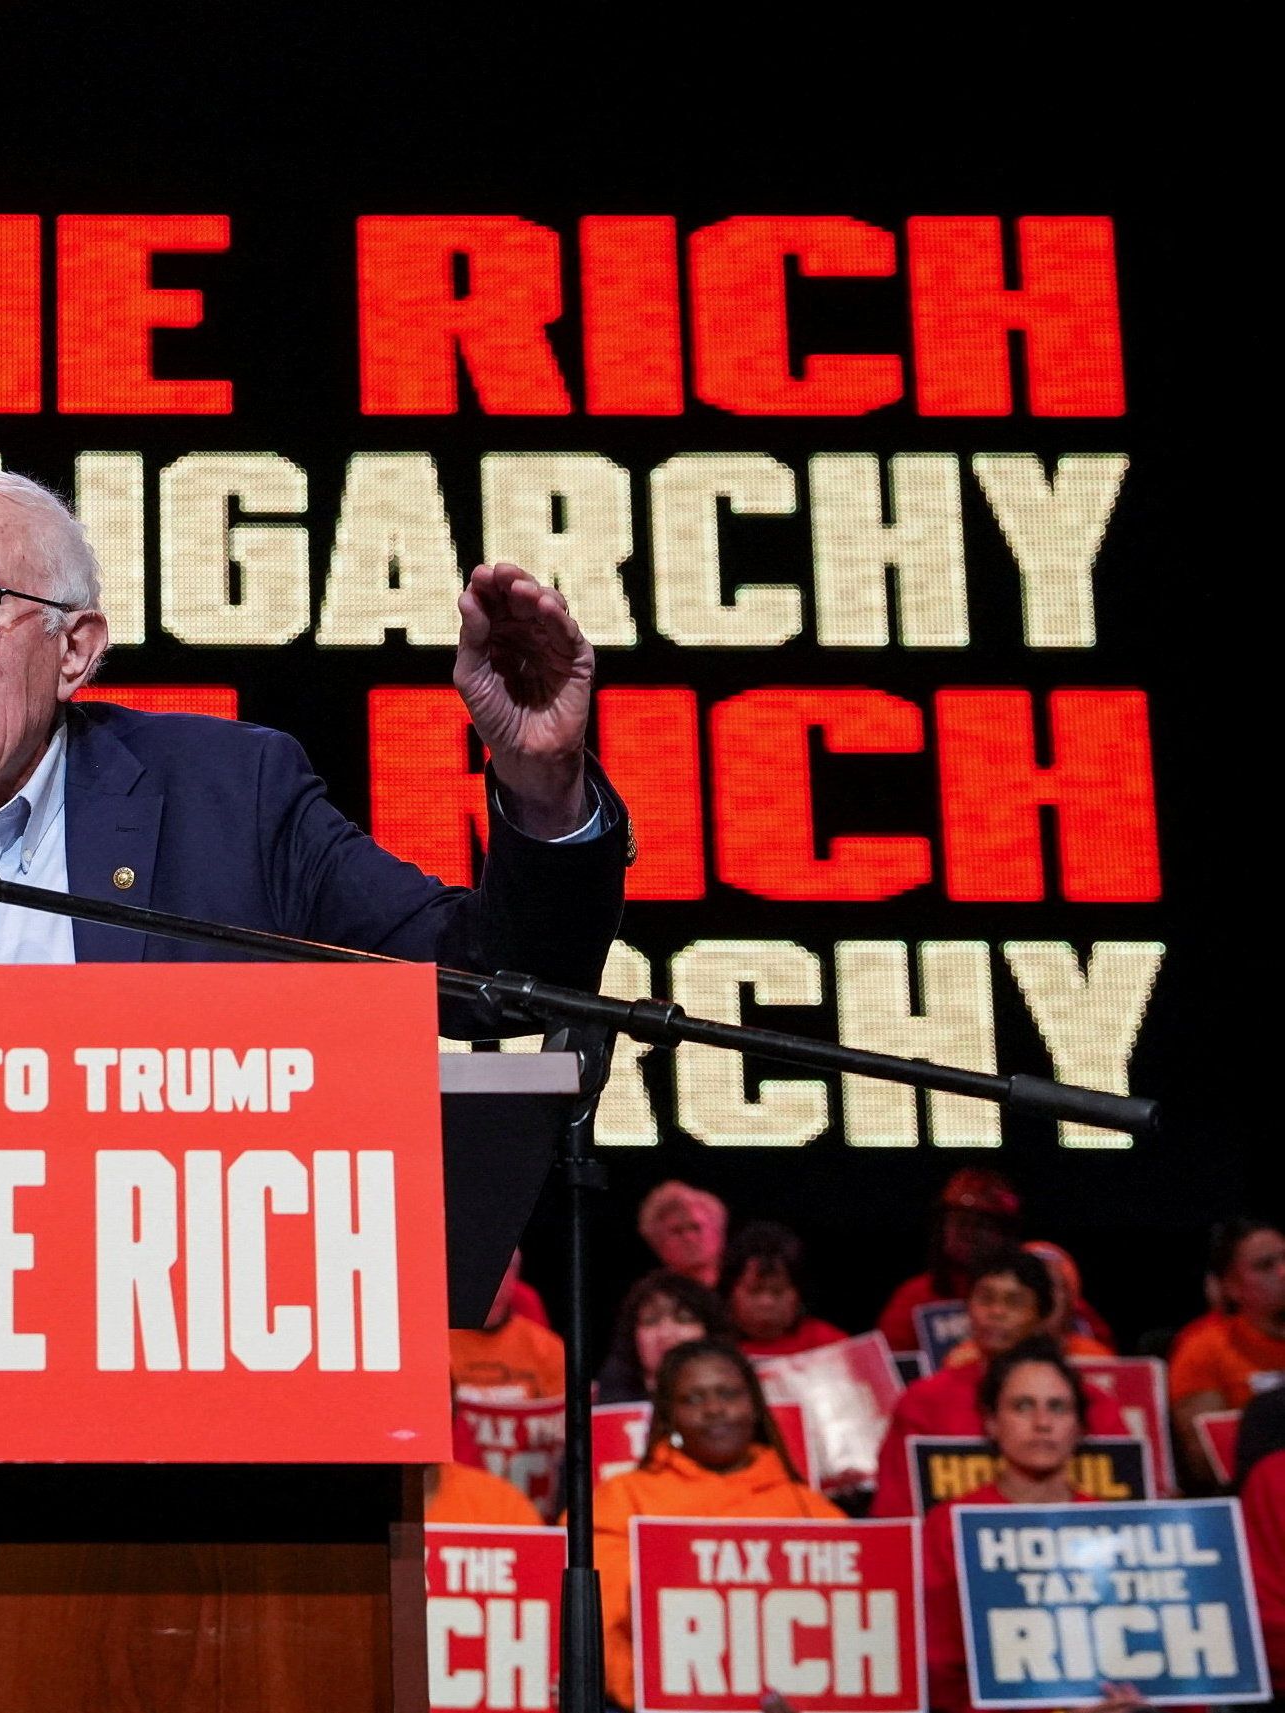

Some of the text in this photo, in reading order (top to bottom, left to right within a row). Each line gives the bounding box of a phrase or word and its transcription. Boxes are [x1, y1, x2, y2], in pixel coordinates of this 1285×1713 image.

[356, 215, 1126, 417] RICH
[73, 1047, 316, 1114] TRUMP
[94, 1149, 402, 1373] RICH
[439, 1546, 518, 1595] THE
[690, 1539, 862, 1585] TAX THE
[1017, 1568, 1191, 1605] TAX THE
[658, 1588, 902, 1697] RICH
[987, 1600, 1239, 1684] RICH
